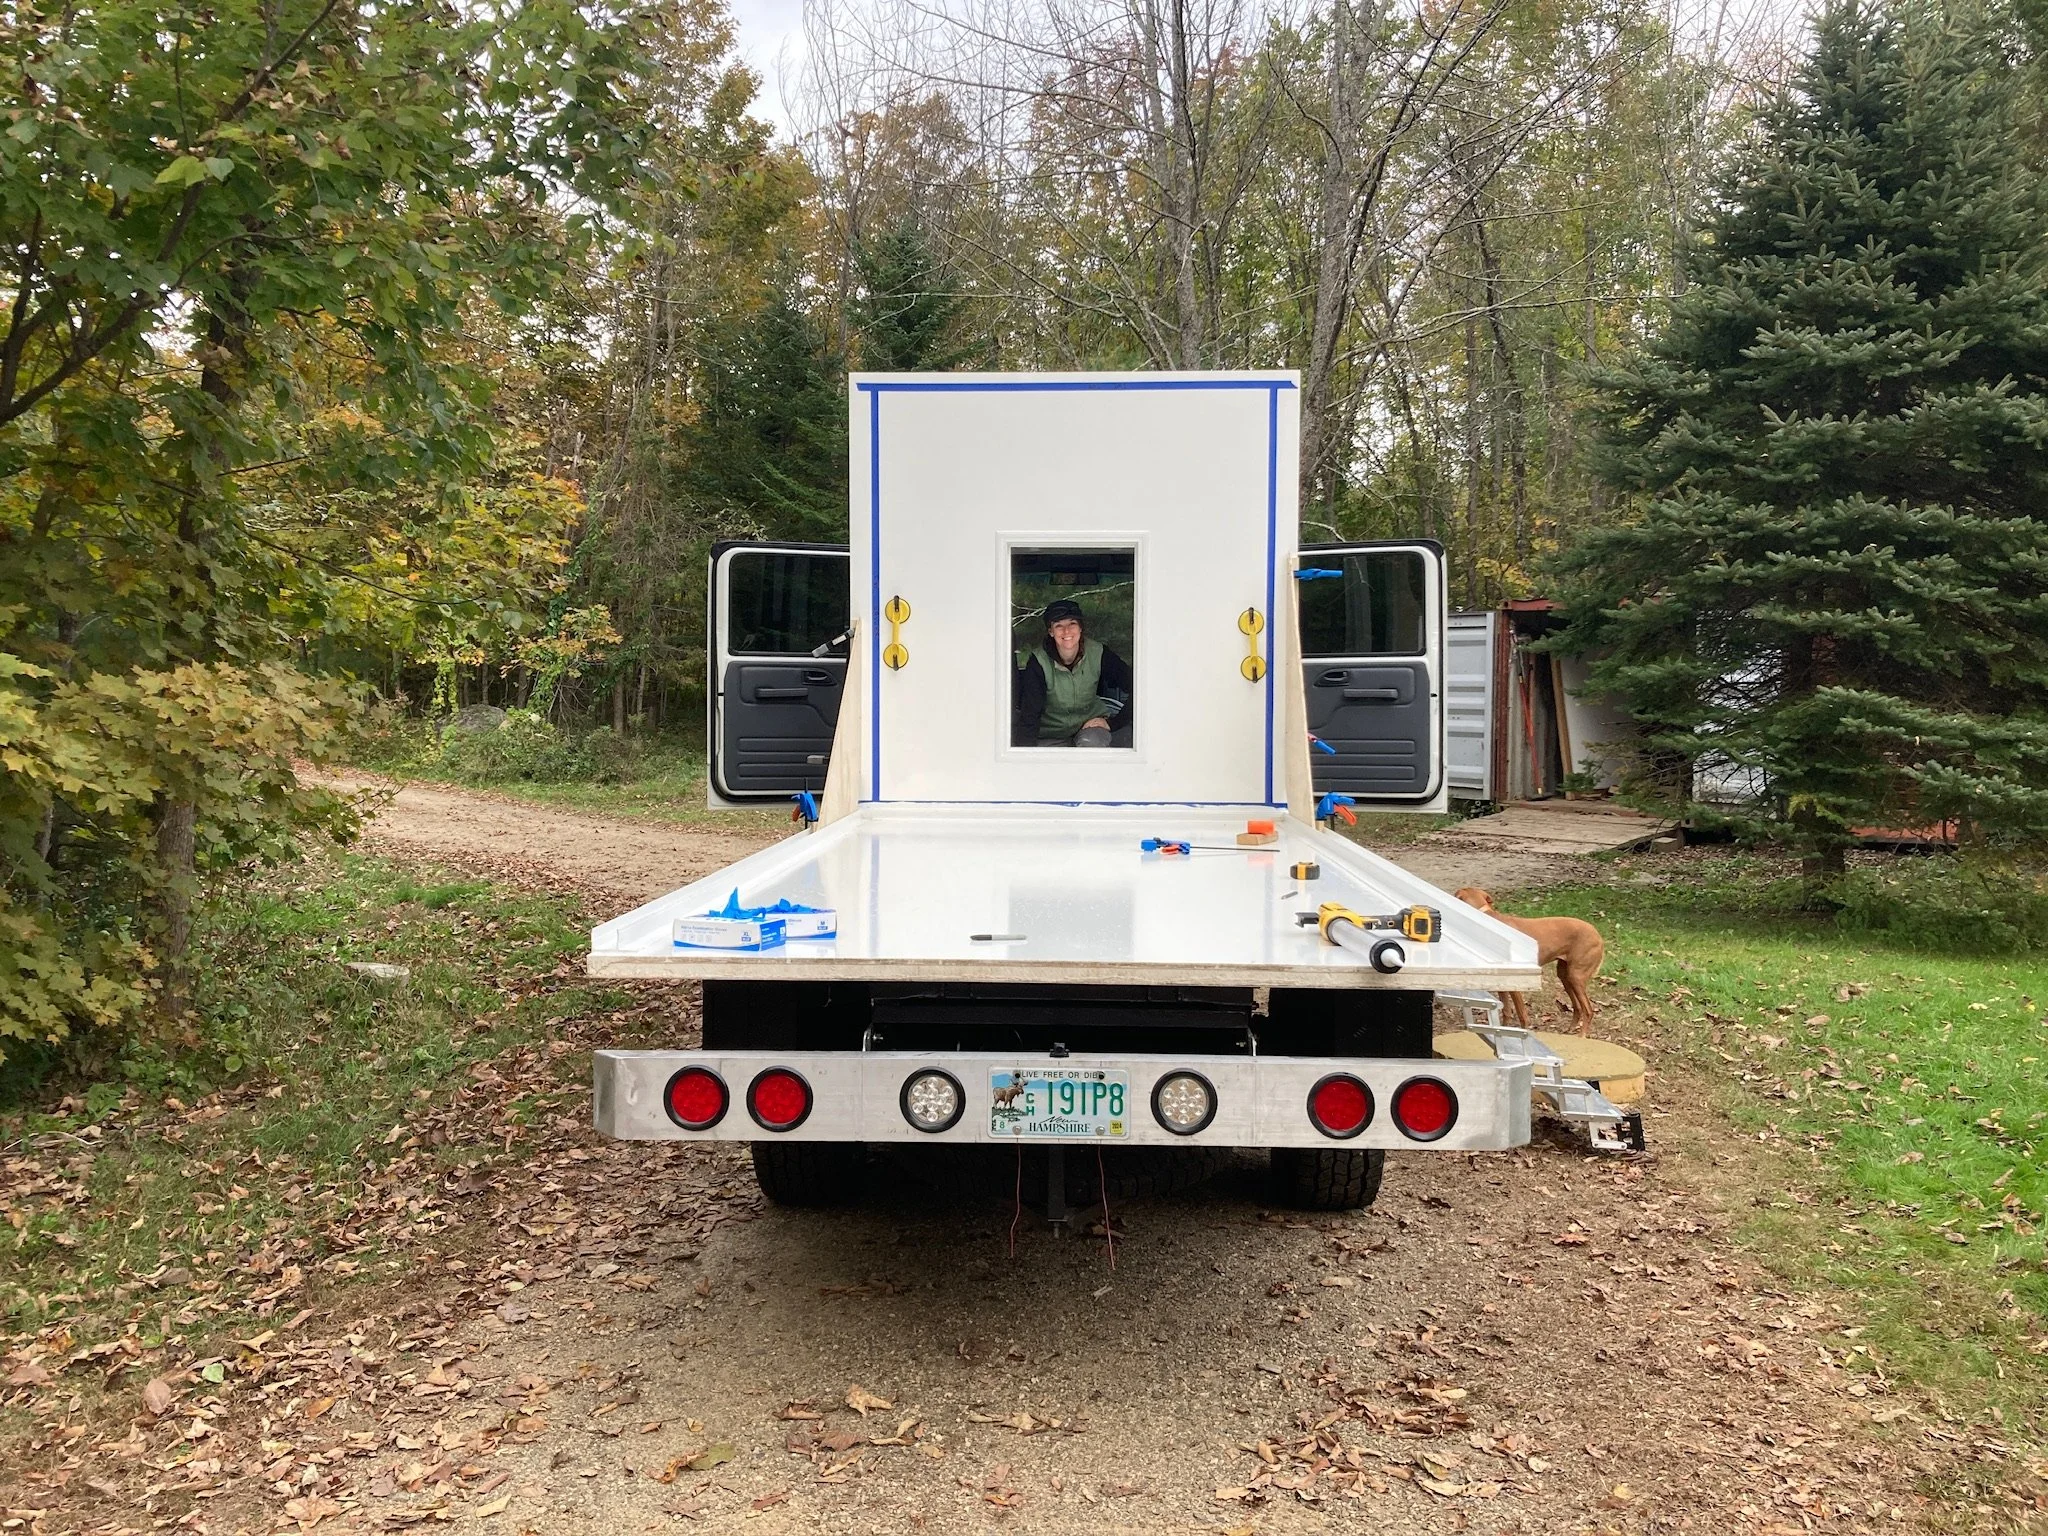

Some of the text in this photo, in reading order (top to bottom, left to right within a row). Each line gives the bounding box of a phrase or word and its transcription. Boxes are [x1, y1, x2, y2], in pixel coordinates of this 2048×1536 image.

[1021, 1070, 1038, 1078] LIVE
[1068, 1071, 1080, 1079] OR
[1047, 1081, 1124, 1116] 191P8
[999, 1121, 1006, 1129] 8
[1029, 1122, 1091, 1134] HAMPSHIRE
